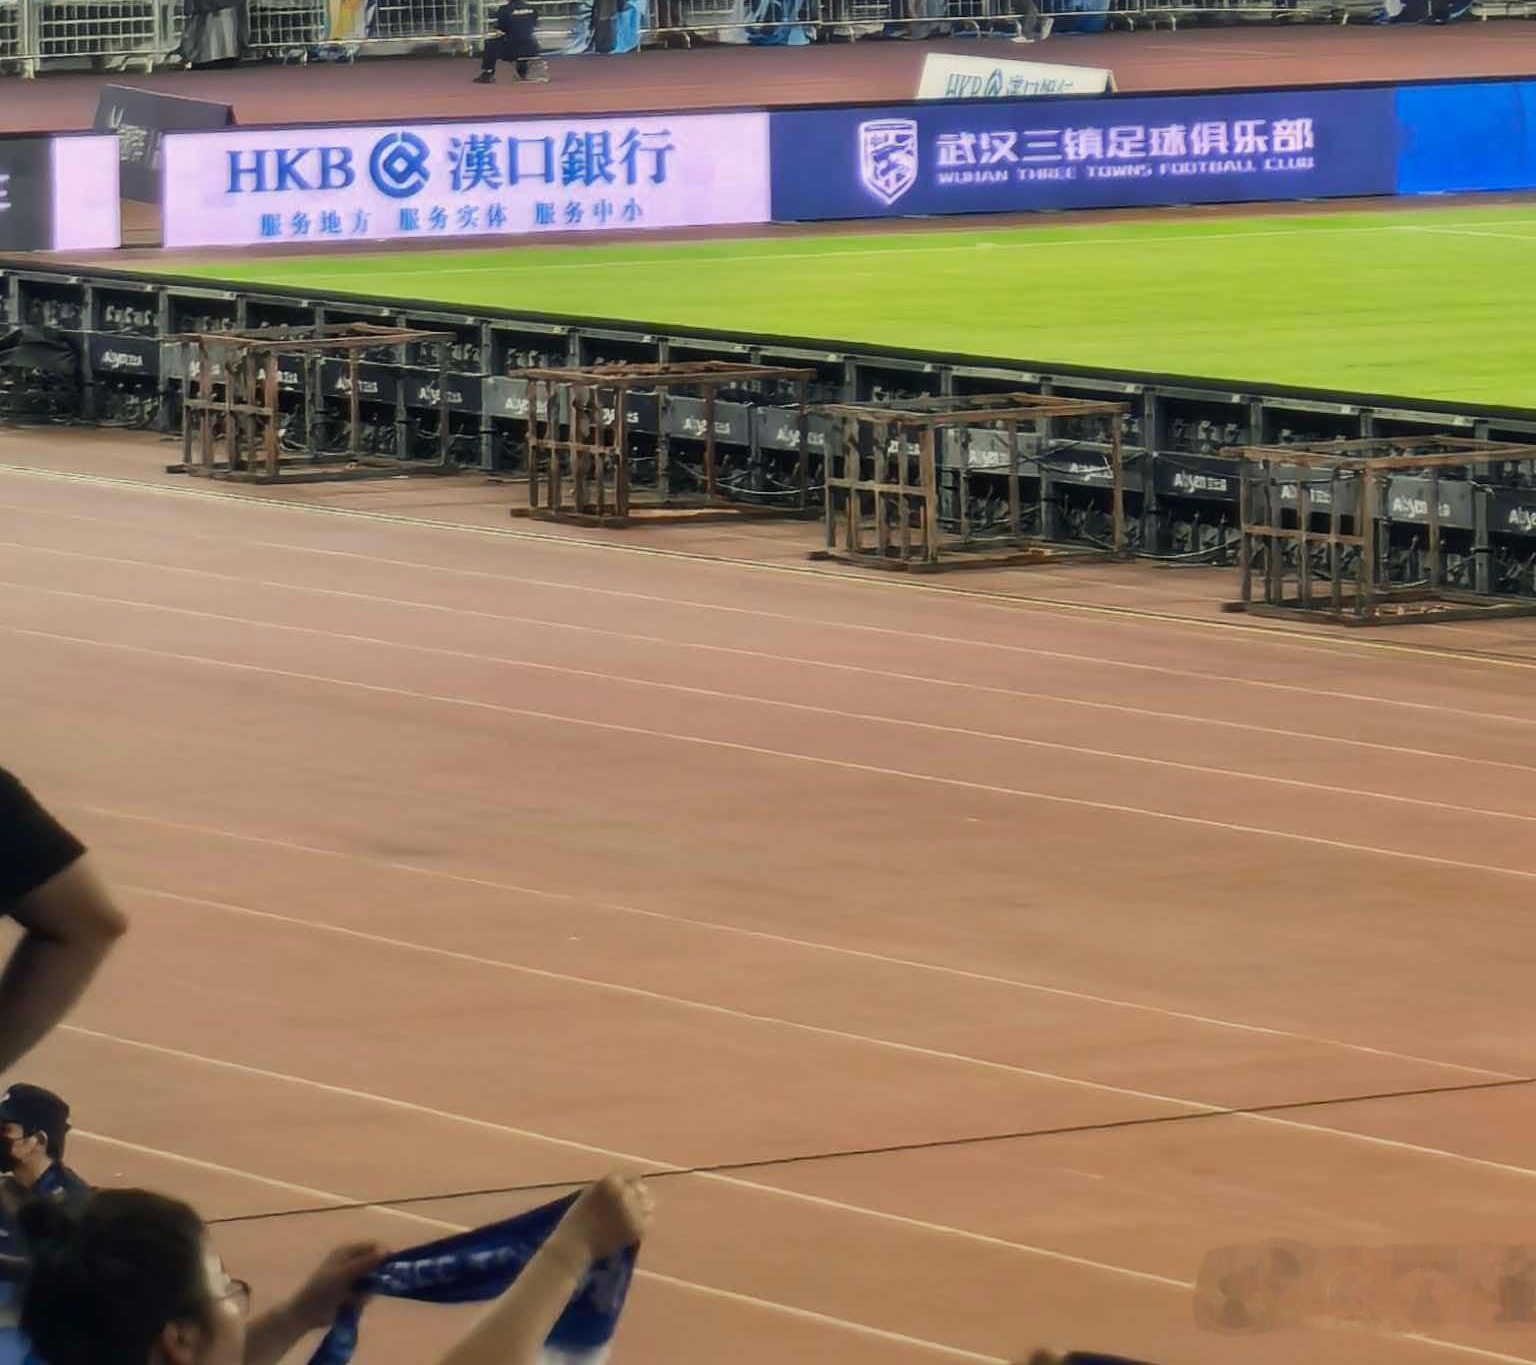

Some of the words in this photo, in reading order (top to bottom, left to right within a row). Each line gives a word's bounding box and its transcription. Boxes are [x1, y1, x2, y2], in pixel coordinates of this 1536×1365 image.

[446, 127, 676, 192] 漢口銀行
[936, 117, 1314, 166] 武汉三镇足球俱乐部
[226, 146, 356, 193] HKB
[260, 209, 372, 237] 服务地方
[398, 202, 508, 231] 服务实体
[534, 196, 643, 225] 服务中小
